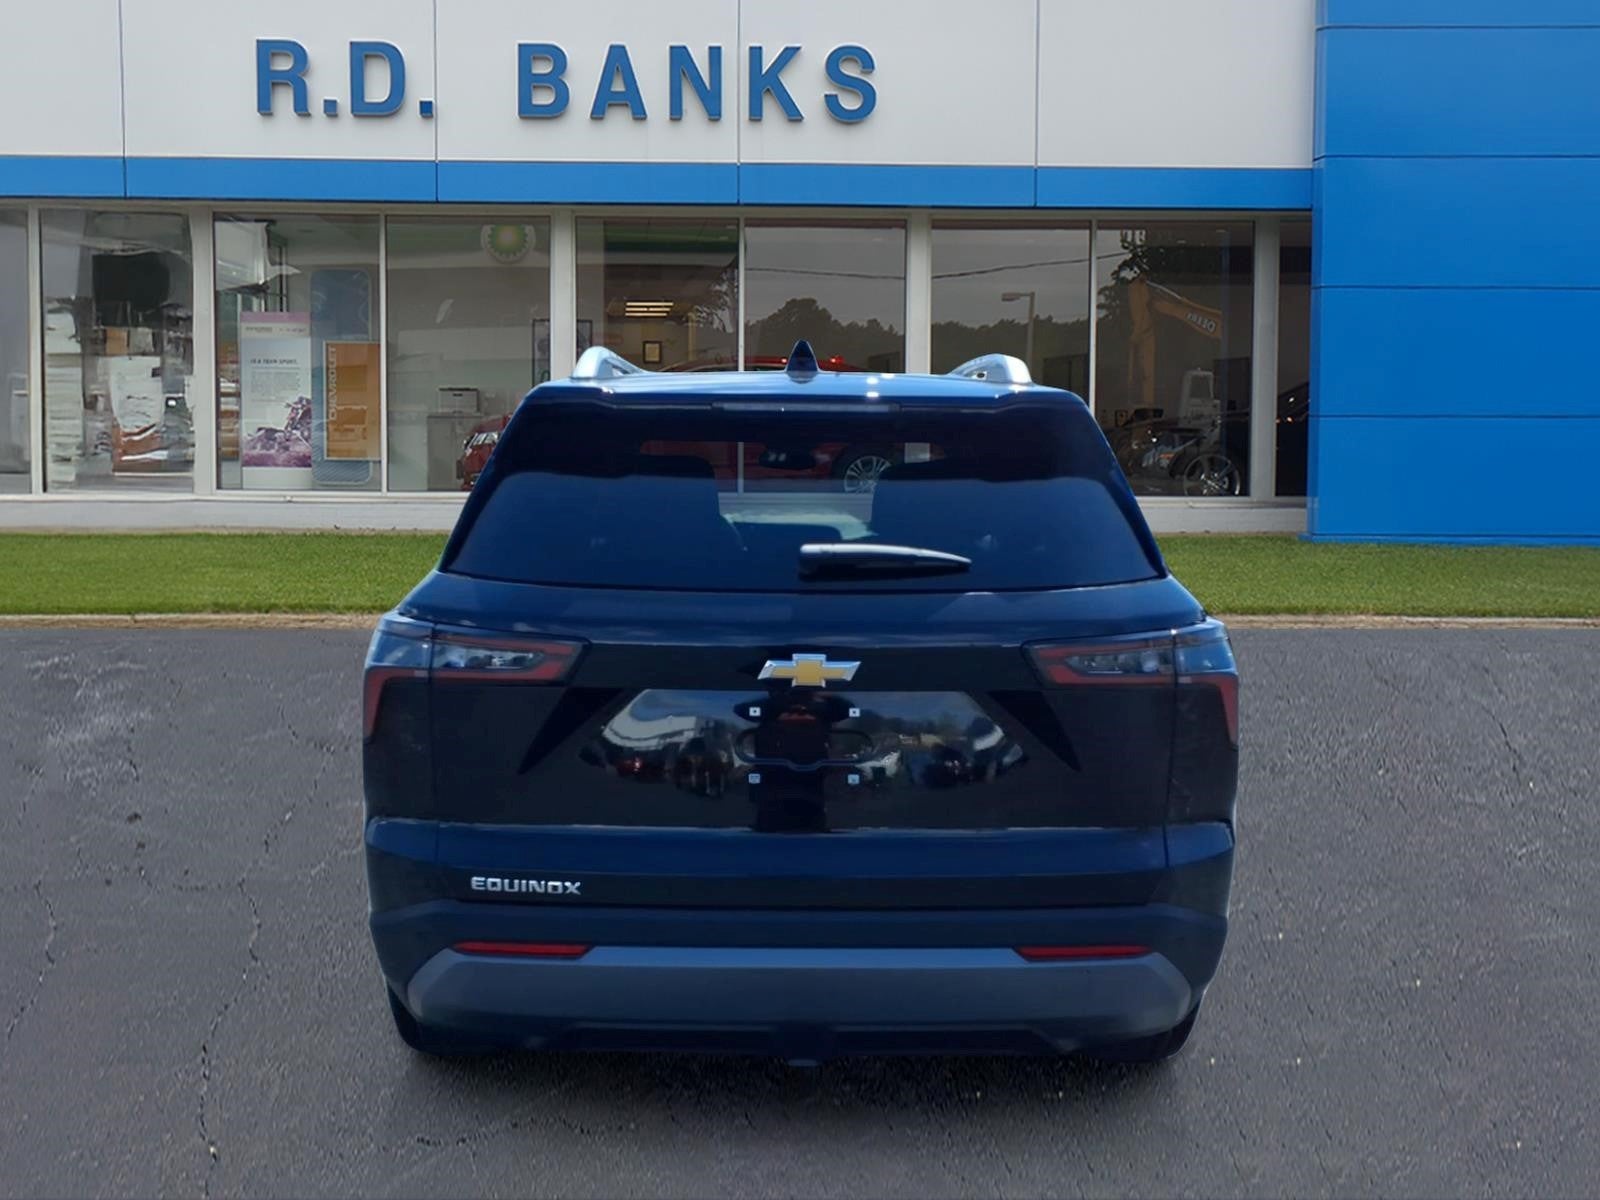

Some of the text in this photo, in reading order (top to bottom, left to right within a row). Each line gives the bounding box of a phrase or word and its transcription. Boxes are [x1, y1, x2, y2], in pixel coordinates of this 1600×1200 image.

[256, 39, 878, 124] R.D. BANKS
[471, 876, 581, 895] EQUINOX
